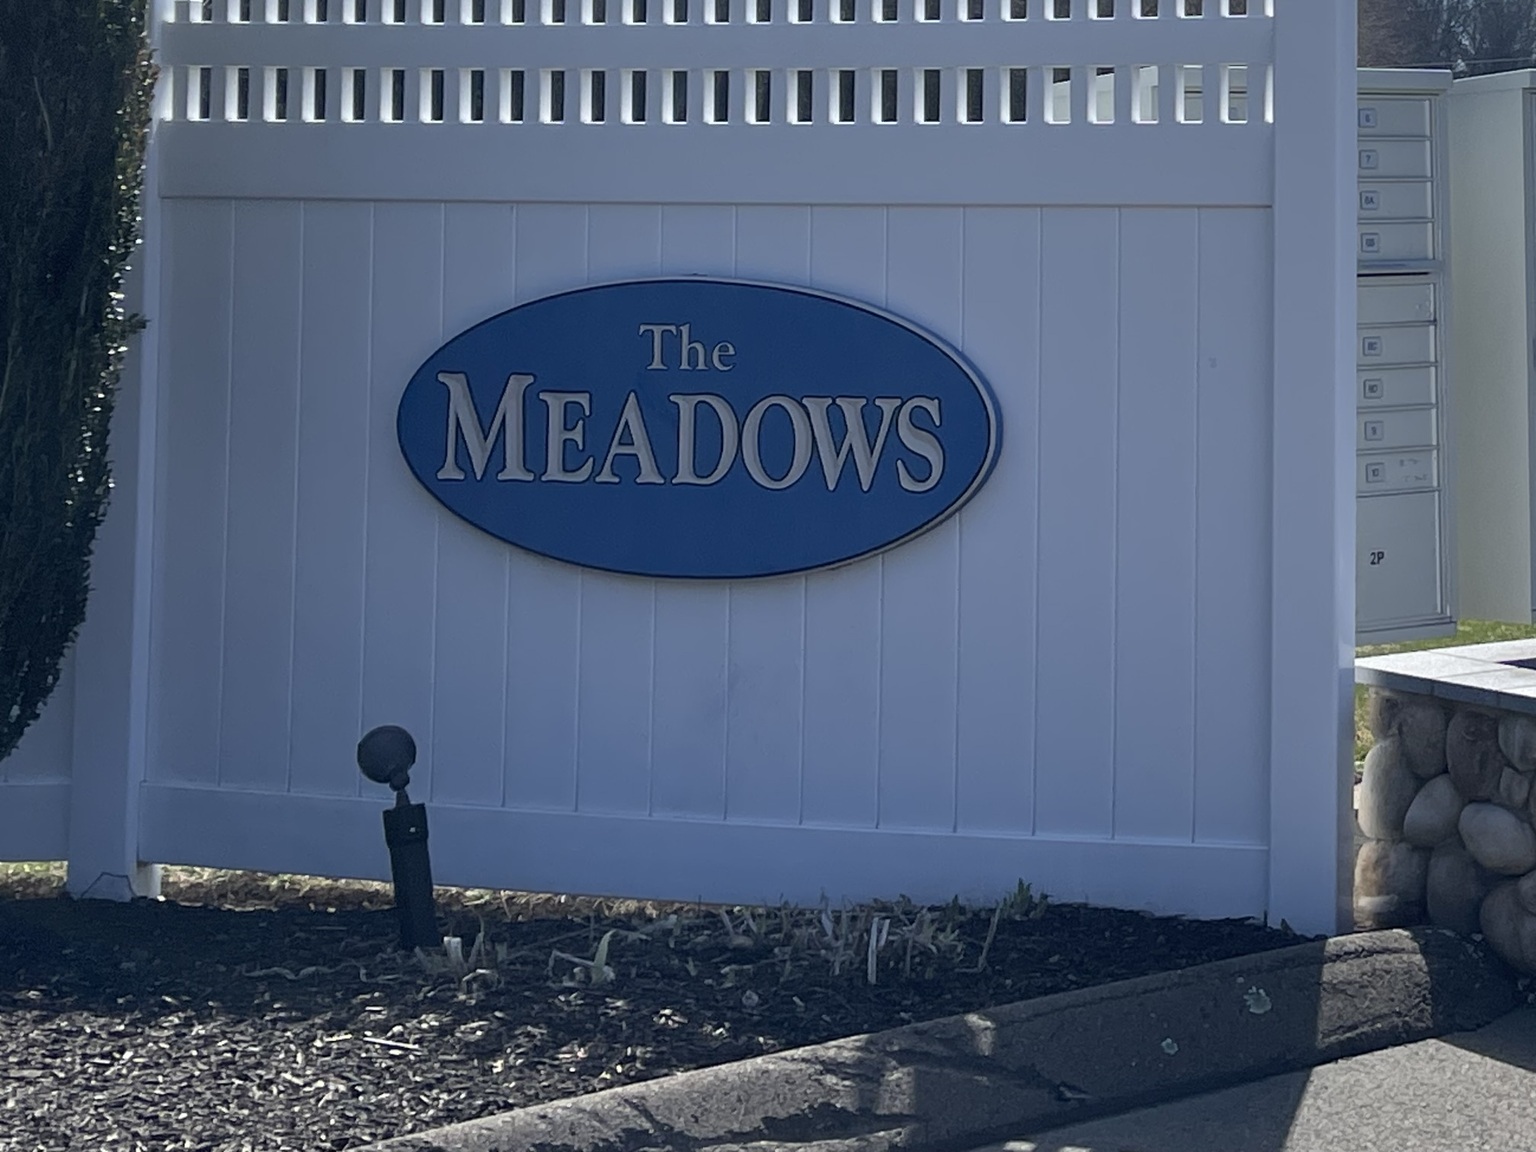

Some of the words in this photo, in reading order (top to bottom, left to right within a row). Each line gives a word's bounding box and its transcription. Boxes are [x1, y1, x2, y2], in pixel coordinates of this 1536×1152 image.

[639, 322, 737, 372] The
[436, 372, 944, 494] MEADOWS
[1370, 551, 1384, 565] 2P
